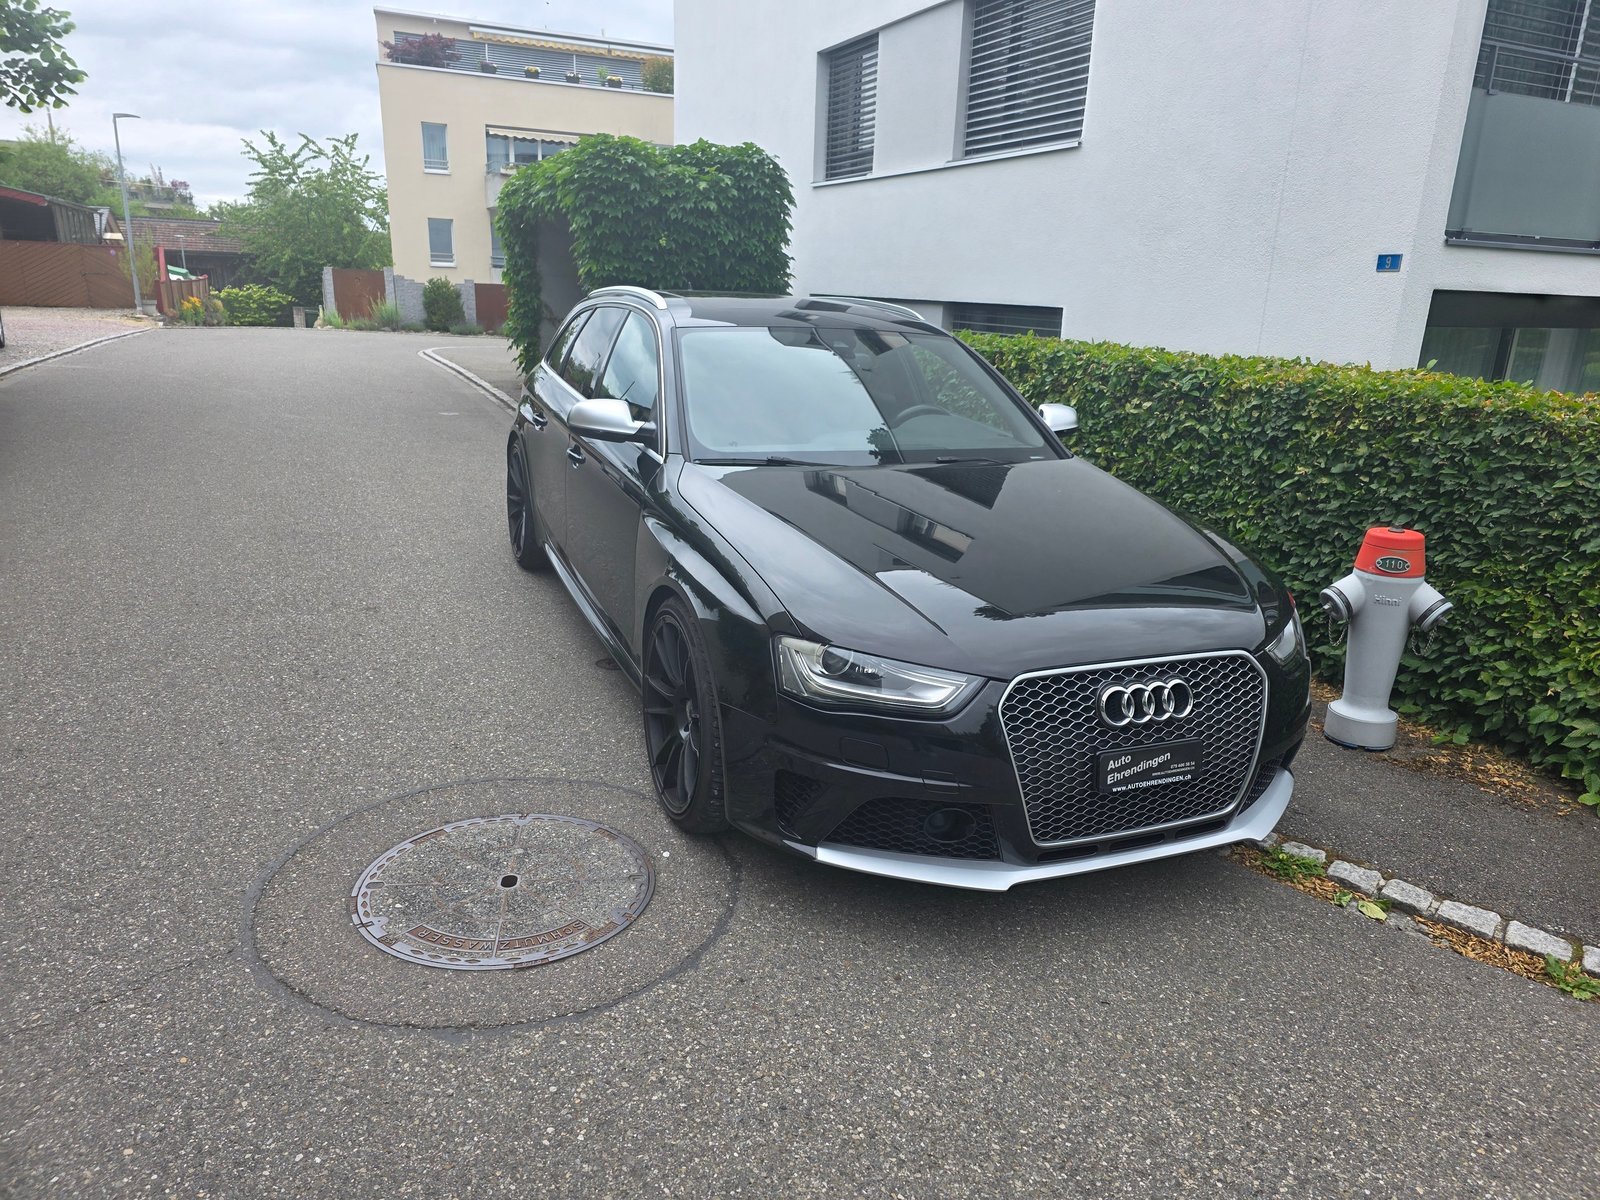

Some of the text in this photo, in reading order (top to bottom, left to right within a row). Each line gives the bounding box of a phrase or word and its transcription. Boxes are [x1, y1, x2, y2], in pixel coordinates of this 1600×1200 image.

[1385, 256, 1392, 269] 9
[1385, 560, 1403, 570] 110
[1107, 755, 1132, 771] Auto
[1107, 752, 1171, 784] Ehrendingen
[1112, 774, 1192, 792] www.AUTOEHRENDINGEN.ch
